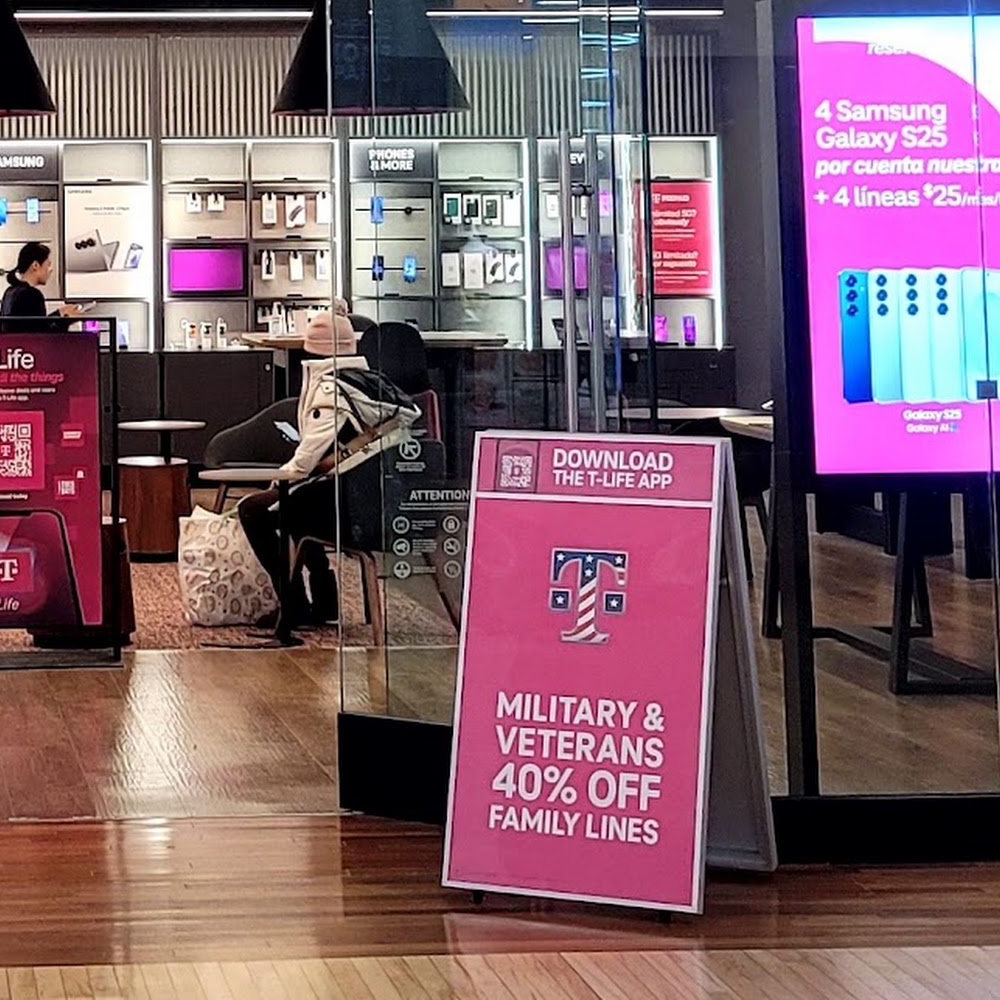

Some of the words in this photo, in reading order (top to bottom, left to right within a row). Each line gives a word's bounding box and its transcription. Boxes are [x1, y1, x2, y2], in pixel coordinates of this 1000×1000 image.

[815, 100, 832, 122] 4
[836, 99, 948, 125] Samsung
[816, 126, 898, 153] Galaxy
[901, 125, 948, 148] S25
[368, 148, 415, 160] PHONES
[380, 160, 414, 171] MORE
[815, 158, 851, 179] por
[853, 156, 924, 174] cuenta
[833, 185, 850, 207] 4
[853, 184, 920, 207] líneas
[9, 372, 28, 383] the
[30, 371, 64, 385] things
[902, 409, 942, 423] Galaxy
[552, 447, 674, 472] DOWNLOAD
[553, 469, 584, 487] THE
[587, 470, 635, 489] T-LIFE
[637, 472, 673, 490] APP
[409, 489, 471, 502] ATTENTION
[496, 690, 638, 729] MILITARY
[643, 702, 665, 732] &
[495, 724, 664, 769] VETERANS
[492, 761, 578, 805] 40%
[587, 769, 662, 811] OFF
[488, 804, 581, 837] FAMILY
[585, 813, 660, 846] LINES
